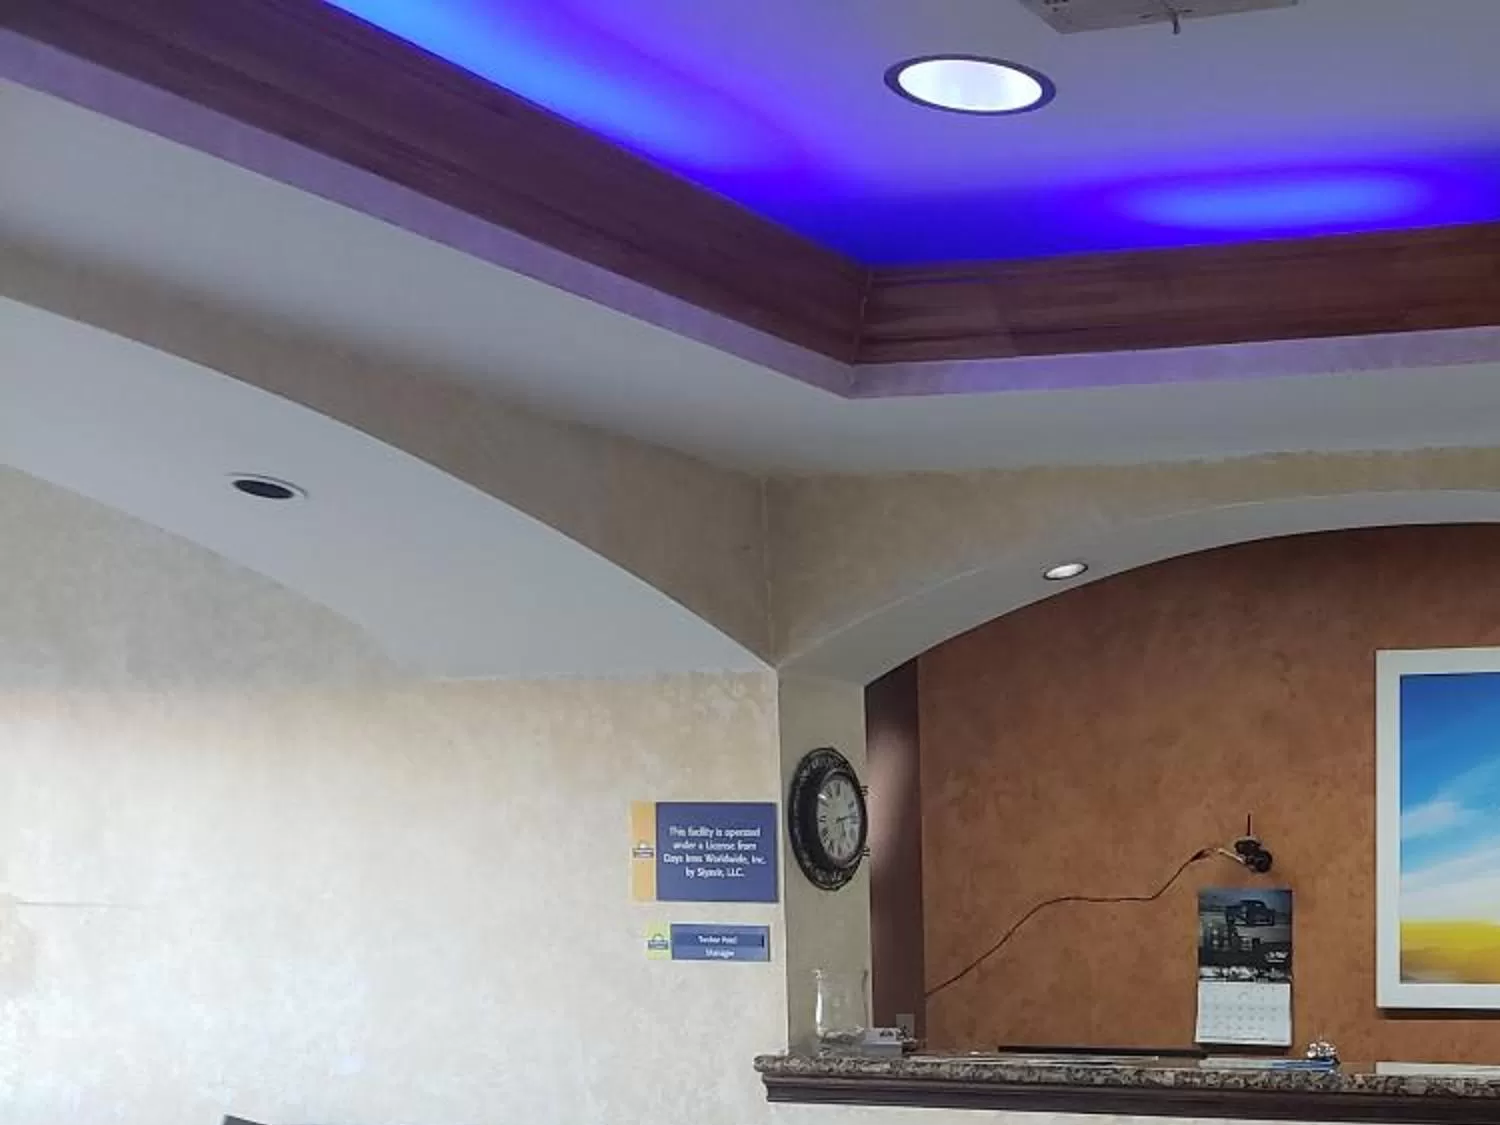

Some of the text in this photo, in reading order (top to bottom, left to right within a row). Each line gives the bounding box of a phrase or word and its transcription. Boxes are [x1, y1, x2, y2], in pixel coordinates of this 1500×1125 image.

[669, 826, 761, 839] This facility is operated
[673, 841, 696, 850] under
[706, 841, 736, 851] License
[738, 840, 757, 851] from
[664, 854, 683, 865] Days
[686, 854, 702, 863] Inns
[704, 854, 750, 865] Worldwide,
[685, 867, 695, 878] by
[705, 949, 735, 959] Manager
